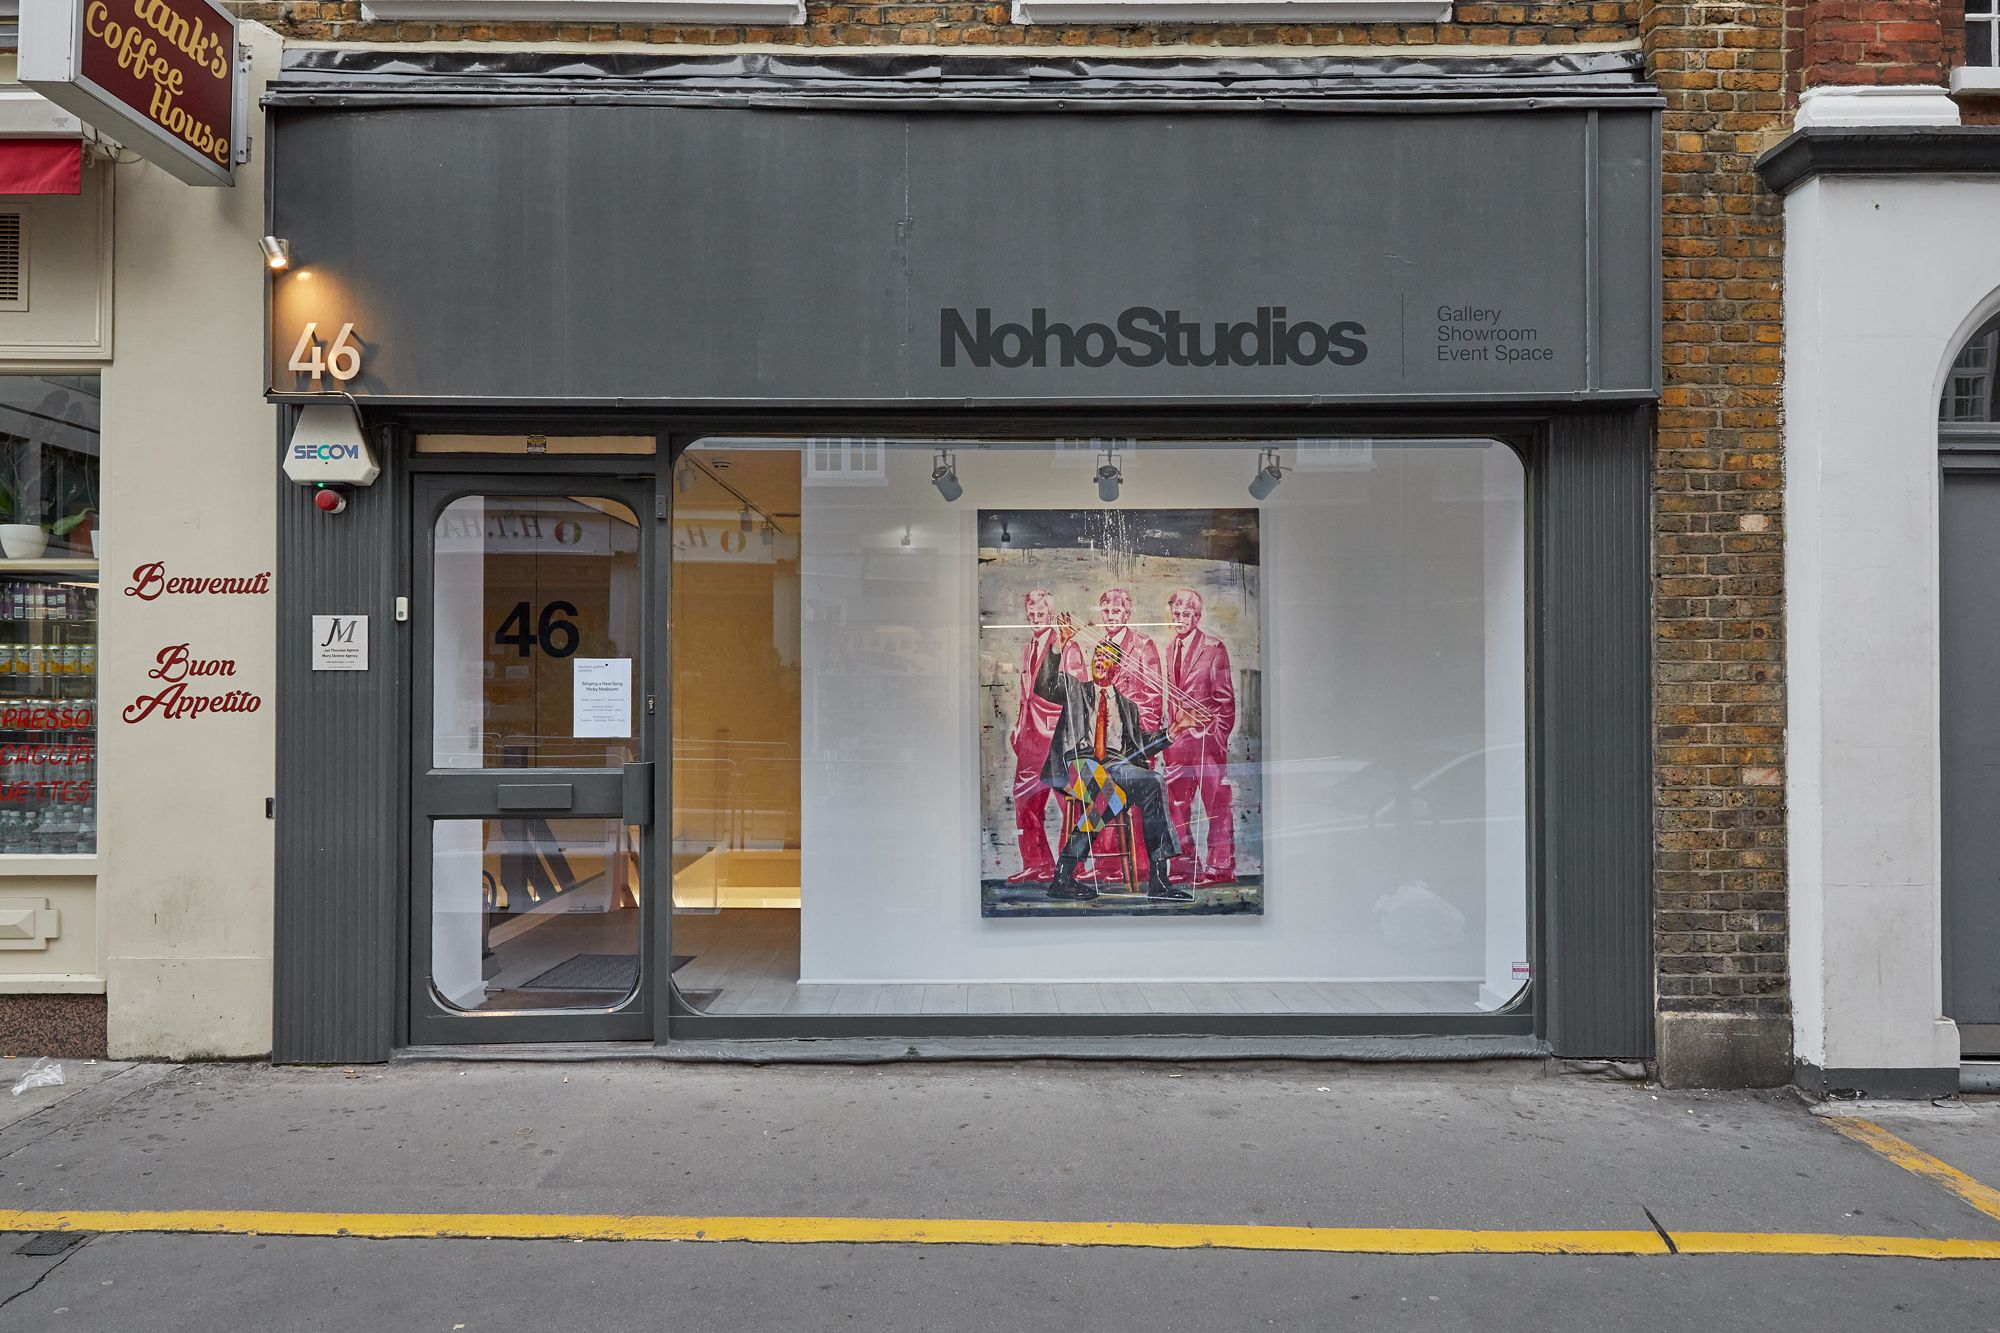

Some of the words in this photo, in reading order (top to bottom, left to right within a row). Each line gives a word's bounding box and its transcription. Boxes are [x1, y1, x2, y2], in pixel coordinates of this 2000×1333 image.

[86, 1, 183, 96] Coffee
[134, 0, 227, 79] ank's
[150, 82, 230, 165] House
[1437, 305, 1501, 325] Gallery
[1437, 325, 1537, 341] Showroom
[288, 322, 361, 381] 46
[940, 306, 1368, 369] NohoStudios
[1437, 345, 1488, 361] Event
[1495, 344, 1553, 364] Space
[294, 444, 359, 460] SECOM
[124, 561, 271, 601] Benvenuti
[321, 618, 358, 647] JM
[494, 600, 580, 658] 46
[148, 642, 236, 683] Buon
[122, 682, 262, 724] Appetito
